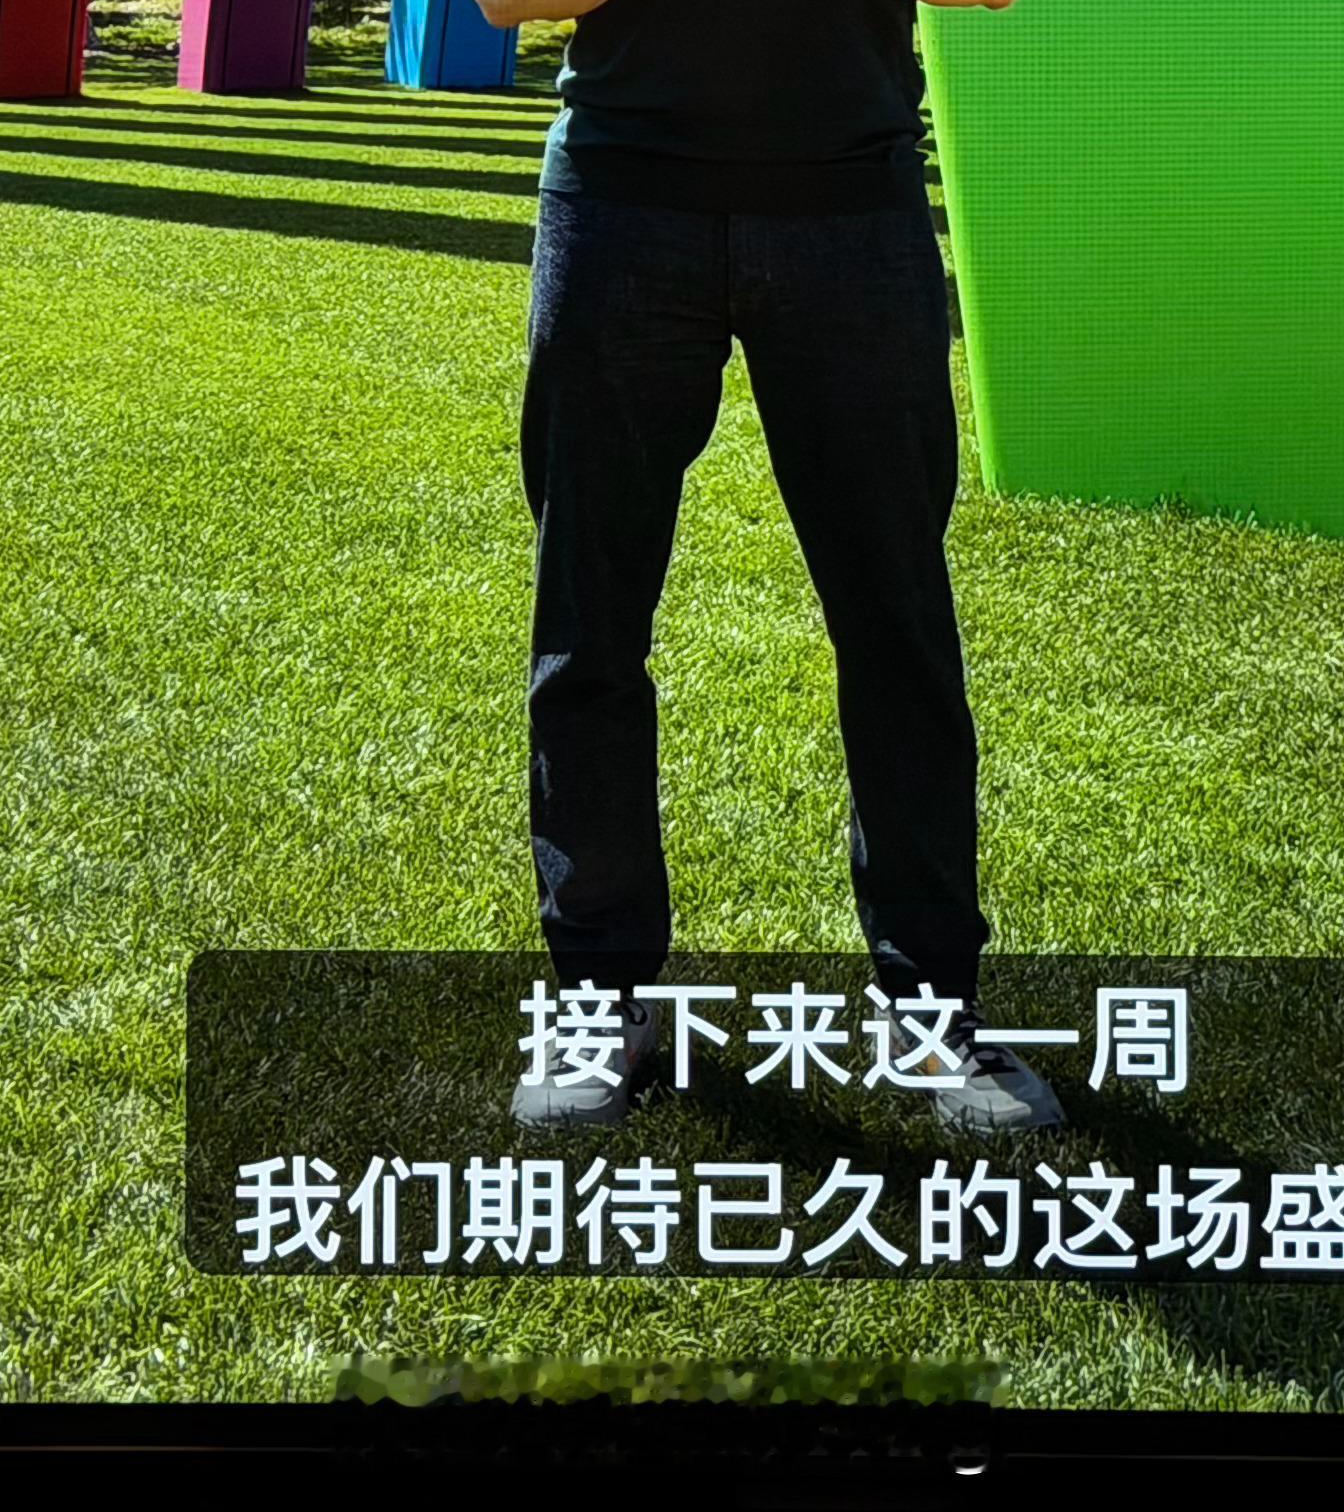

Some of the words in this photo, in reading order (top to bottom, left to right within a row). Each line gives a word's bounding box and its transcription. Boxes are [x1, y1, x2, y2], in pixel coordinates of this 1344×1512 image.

[517, 978, 1189, 1094] 接下来这一周
